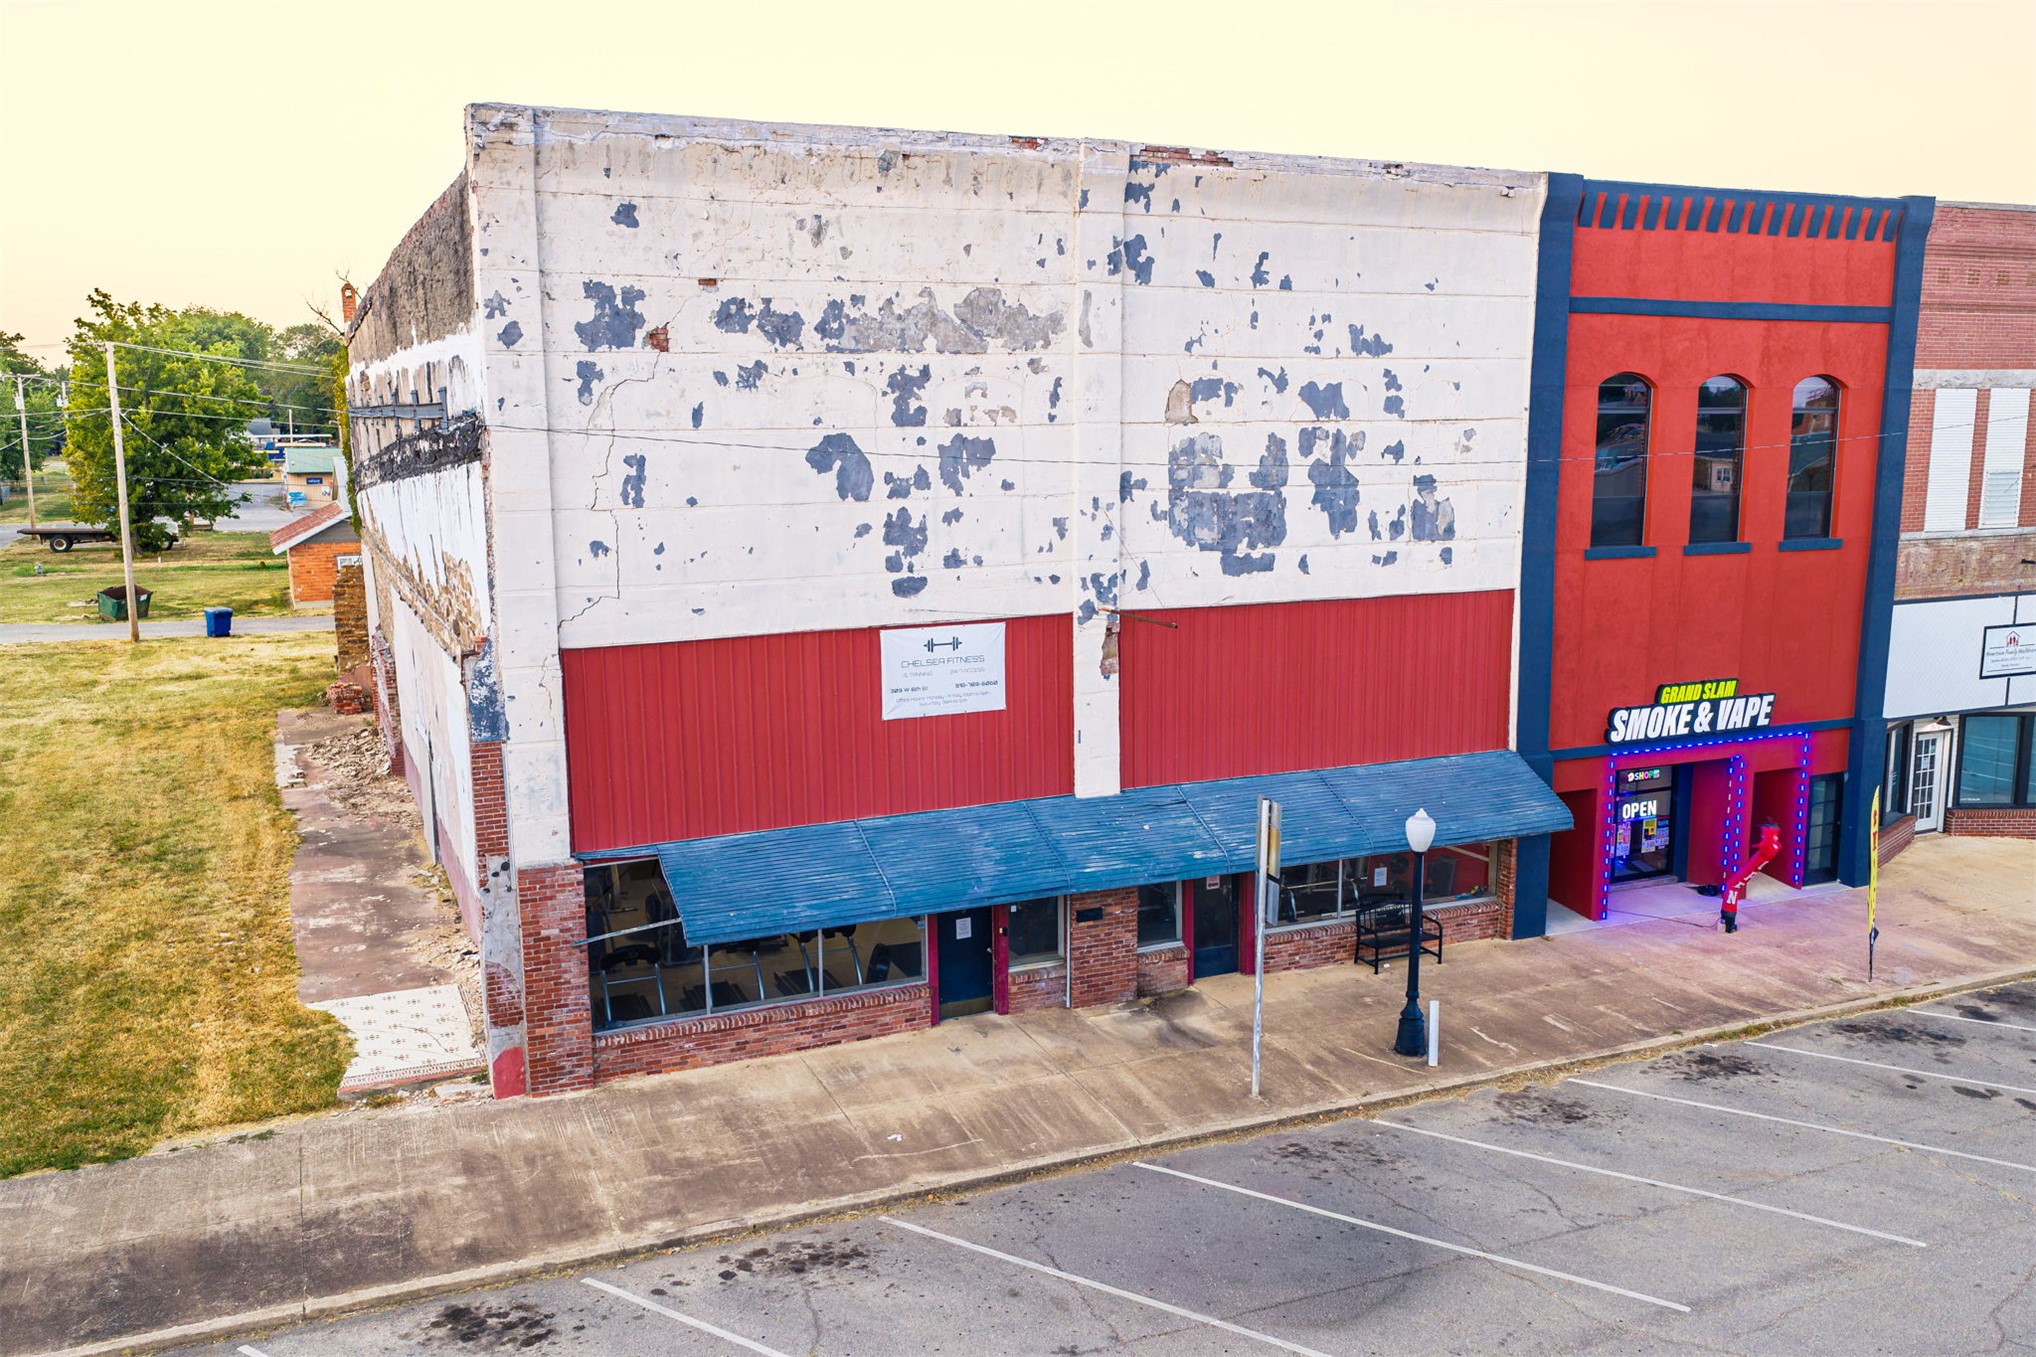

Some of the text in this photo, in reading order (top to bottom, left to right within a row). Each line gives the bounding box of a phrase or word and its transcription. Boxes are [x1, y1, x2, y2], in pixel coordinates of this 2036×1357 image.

[901, 655, 985, 668] CHELSEA FITNESS
[1660, 679, 1738, 704] GRAND SLAM
[1610, 694, 1775, 743] SMOKE & VAPE
[1634, 770, 1654, 781] SHOP
[1622, 799, 1657, 819] OPEN
